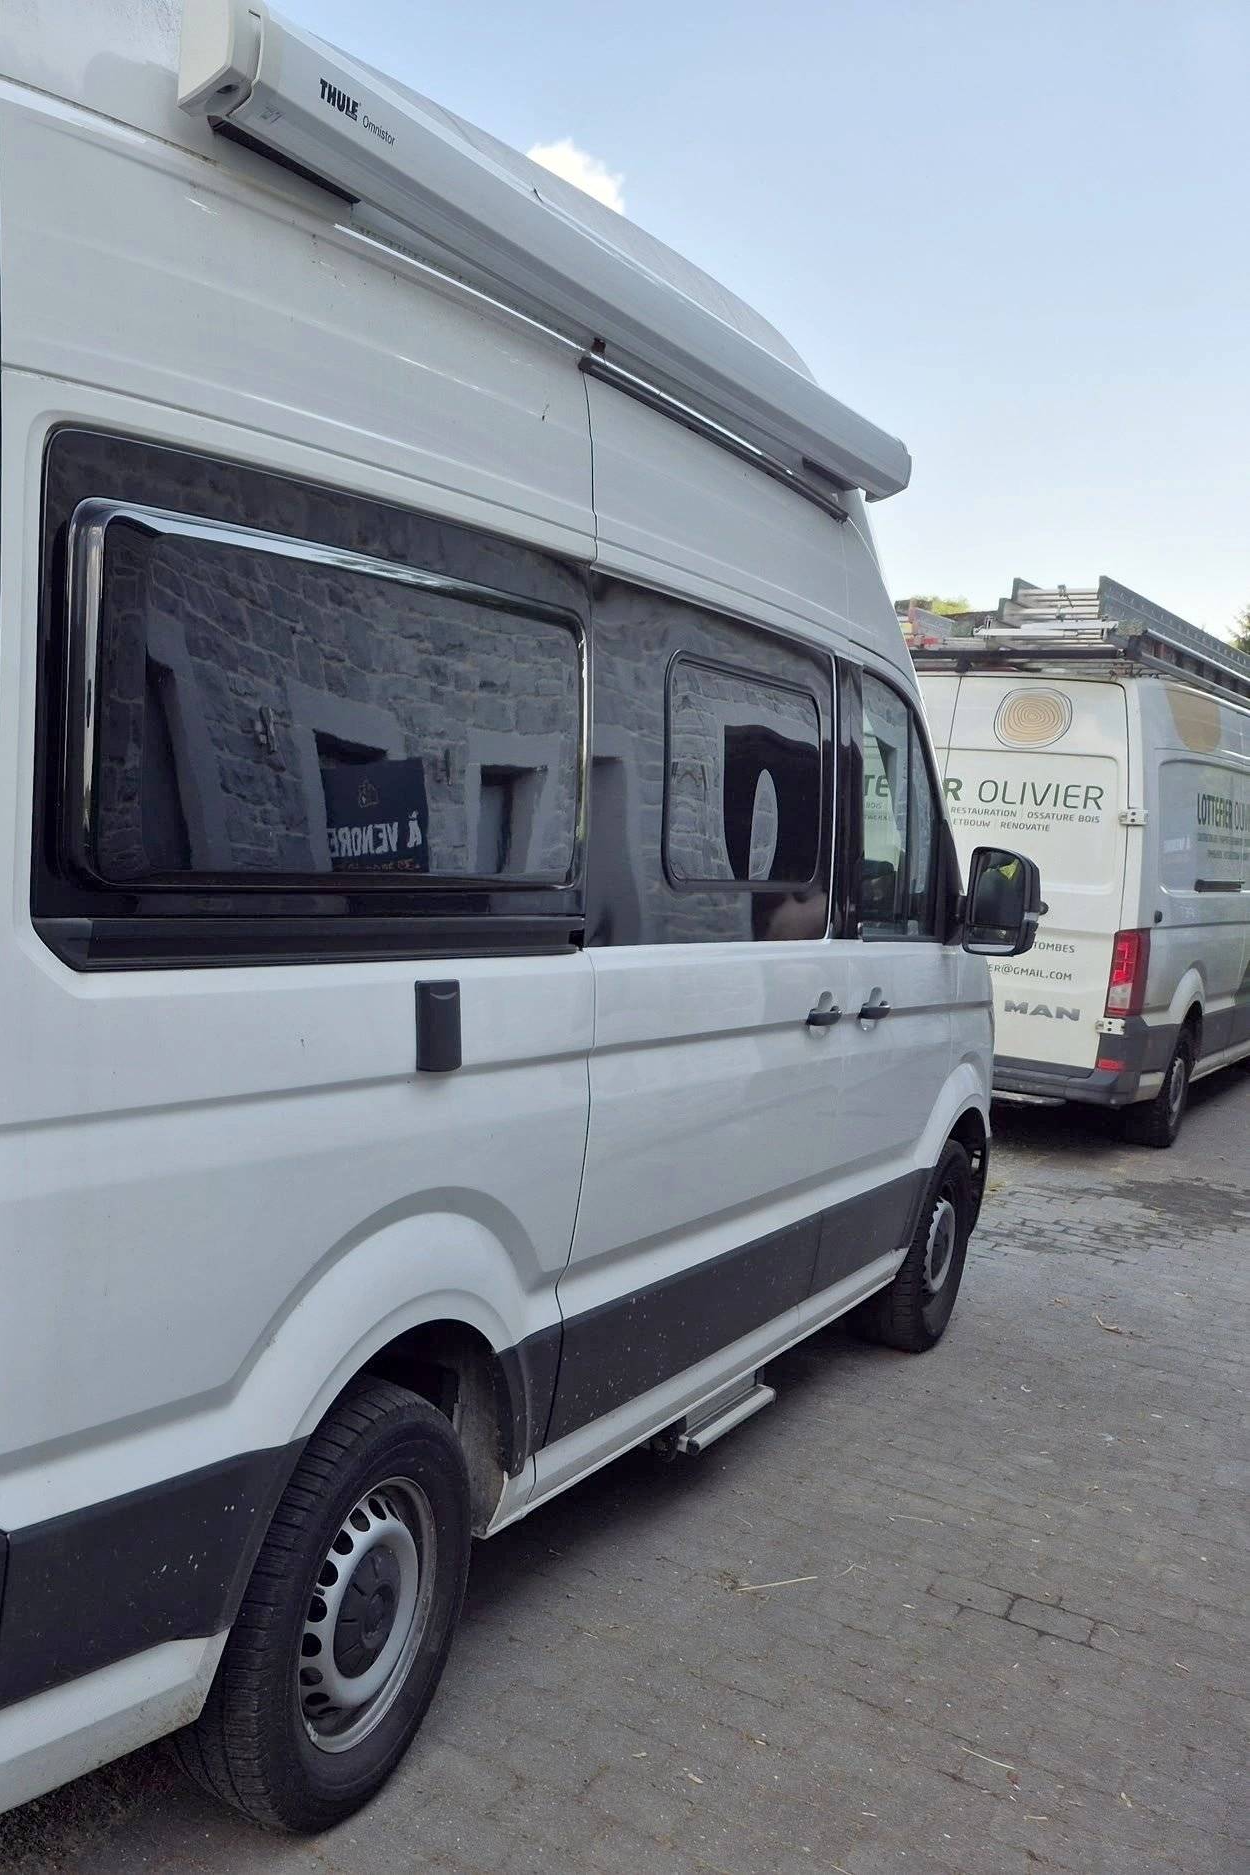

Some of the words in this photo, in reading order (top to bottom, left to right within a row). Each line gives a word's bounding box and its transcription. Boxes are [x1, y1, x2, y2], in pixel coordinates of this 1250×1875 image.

[320, 78, 359, 121] THULE
[362, 115, 396, 146] Omnistor
[978, 779, 1104, 811] OLIVIER
[950, 806, 1017, 818] RESTAURATION
[1027, 811, 1074, 822] OSSATURE
[1078, 814, 1101, 824] BOIS
[953, 818, 991, 828] ETBOUW
[988, 964, 1072, 981] ER@GMAIL.COM
[1004, 999, 1081, 1021] MAN
